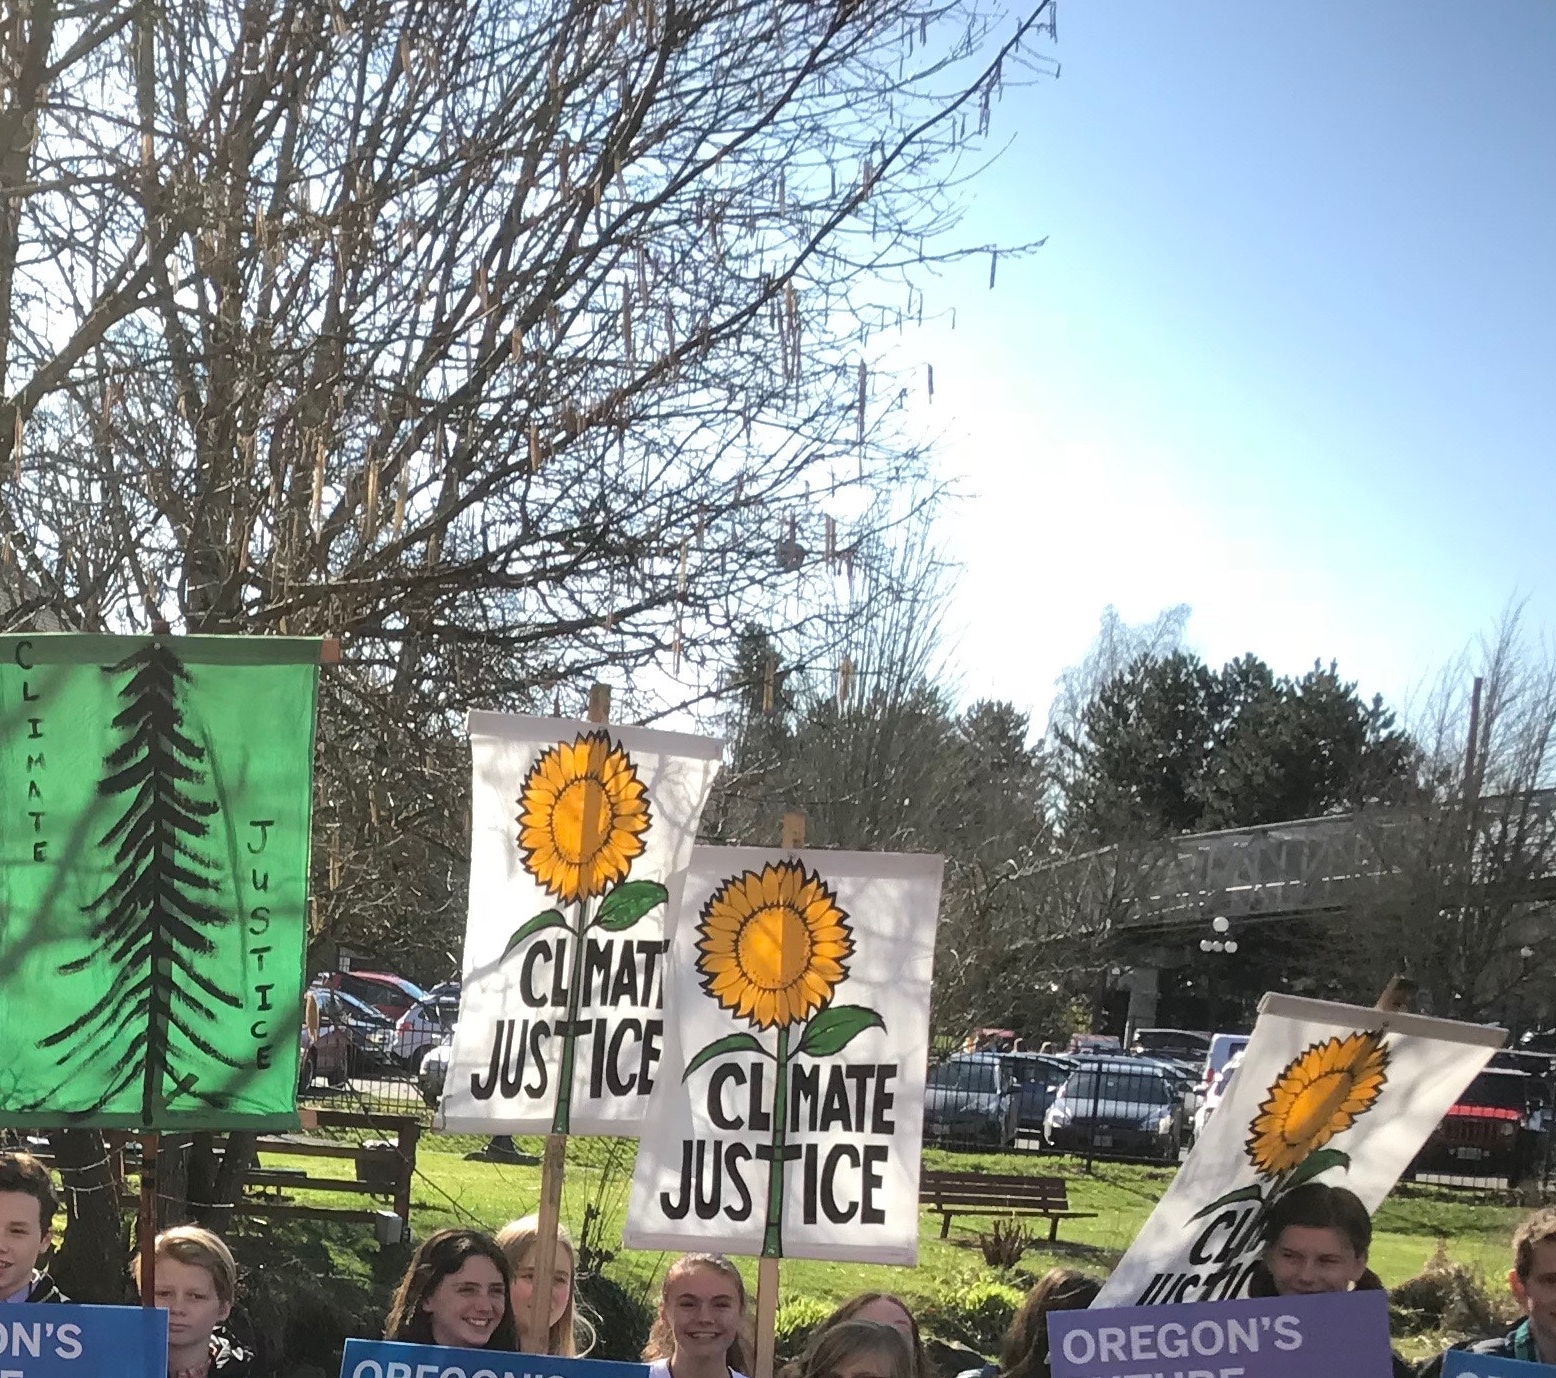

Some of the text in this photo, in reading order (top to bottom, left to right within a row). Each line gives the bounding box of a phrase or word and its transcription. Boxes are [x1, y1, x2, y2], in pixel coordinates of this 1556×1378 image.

[15, 640, 48, 863] CLIMATE
[248, 820, 275, 1071] JUSTICE
[470, 1017, 664, 1099] JUSTICE
[707, 1061, 898, 1134] CLIMATE
[660, 1139, 889, 1225] JUSTICE
[1061, 1315, 1304, 1365] OREGON'S
